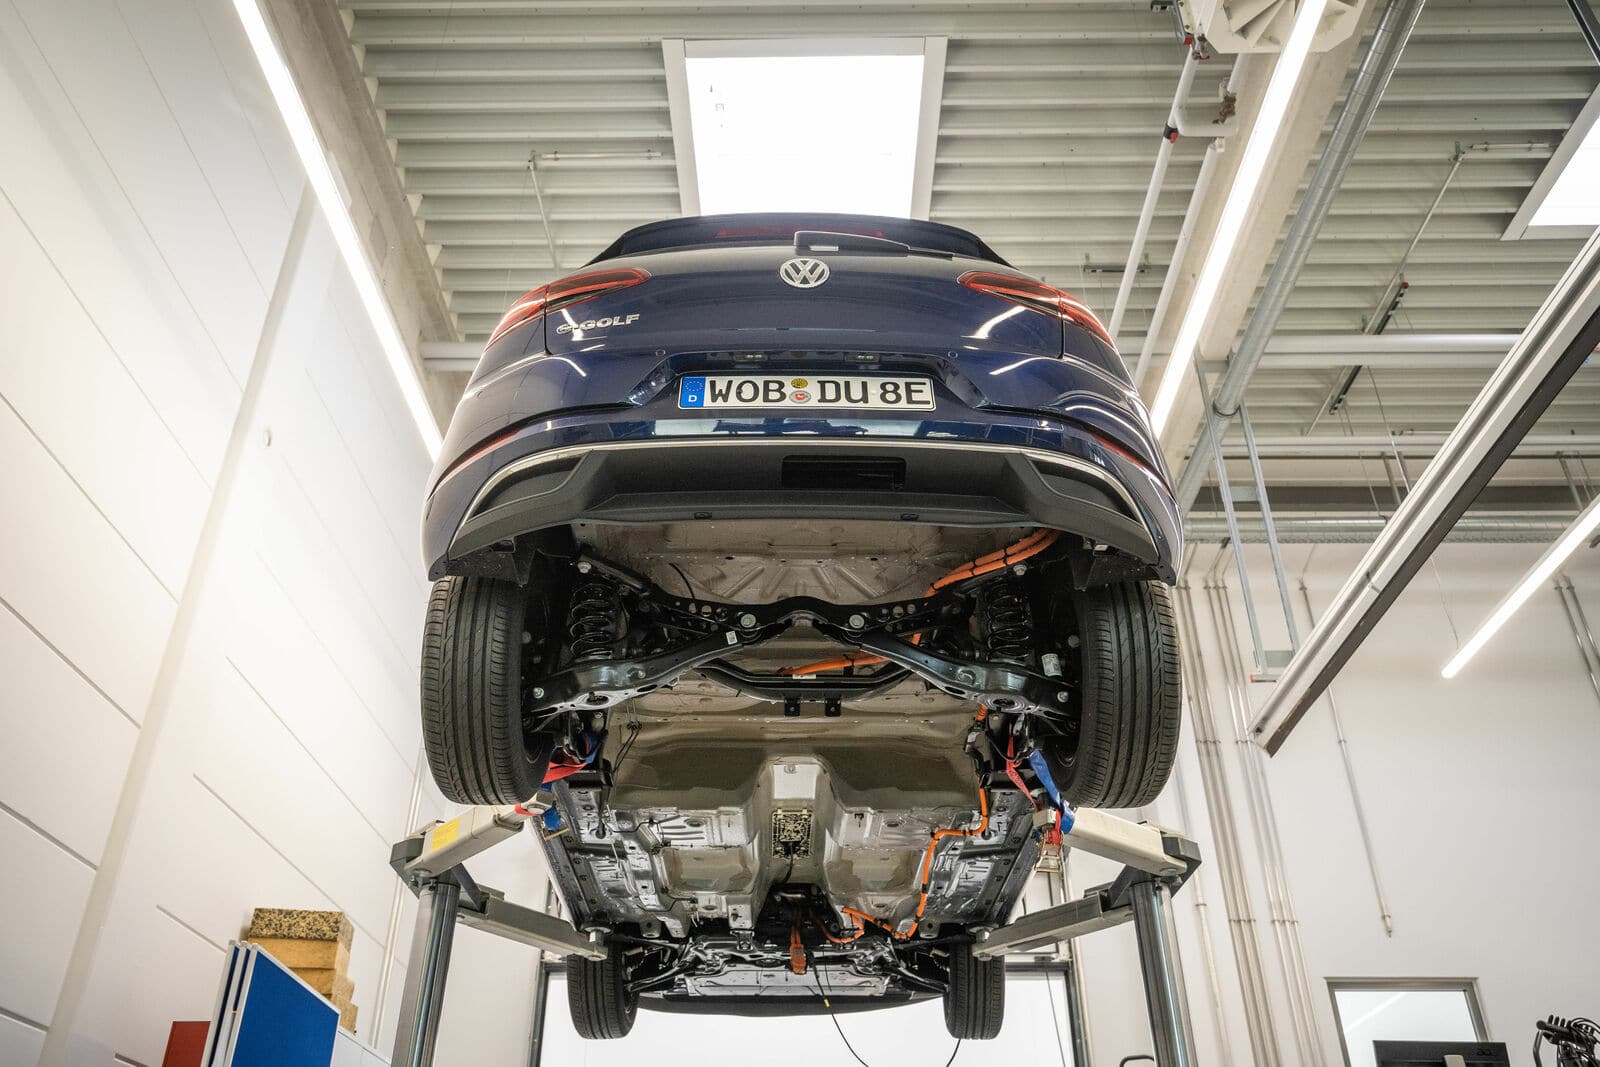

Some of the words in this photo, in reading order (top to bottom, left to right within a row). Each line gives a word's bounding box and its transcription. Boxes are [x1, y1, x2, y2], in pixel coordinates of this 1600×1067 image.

[780, 258, 830, 288] VW
[709, 380, 787, 403] WOB
[817, 380, 868, 404] DU
[879, 381, 931, 405] 8E
